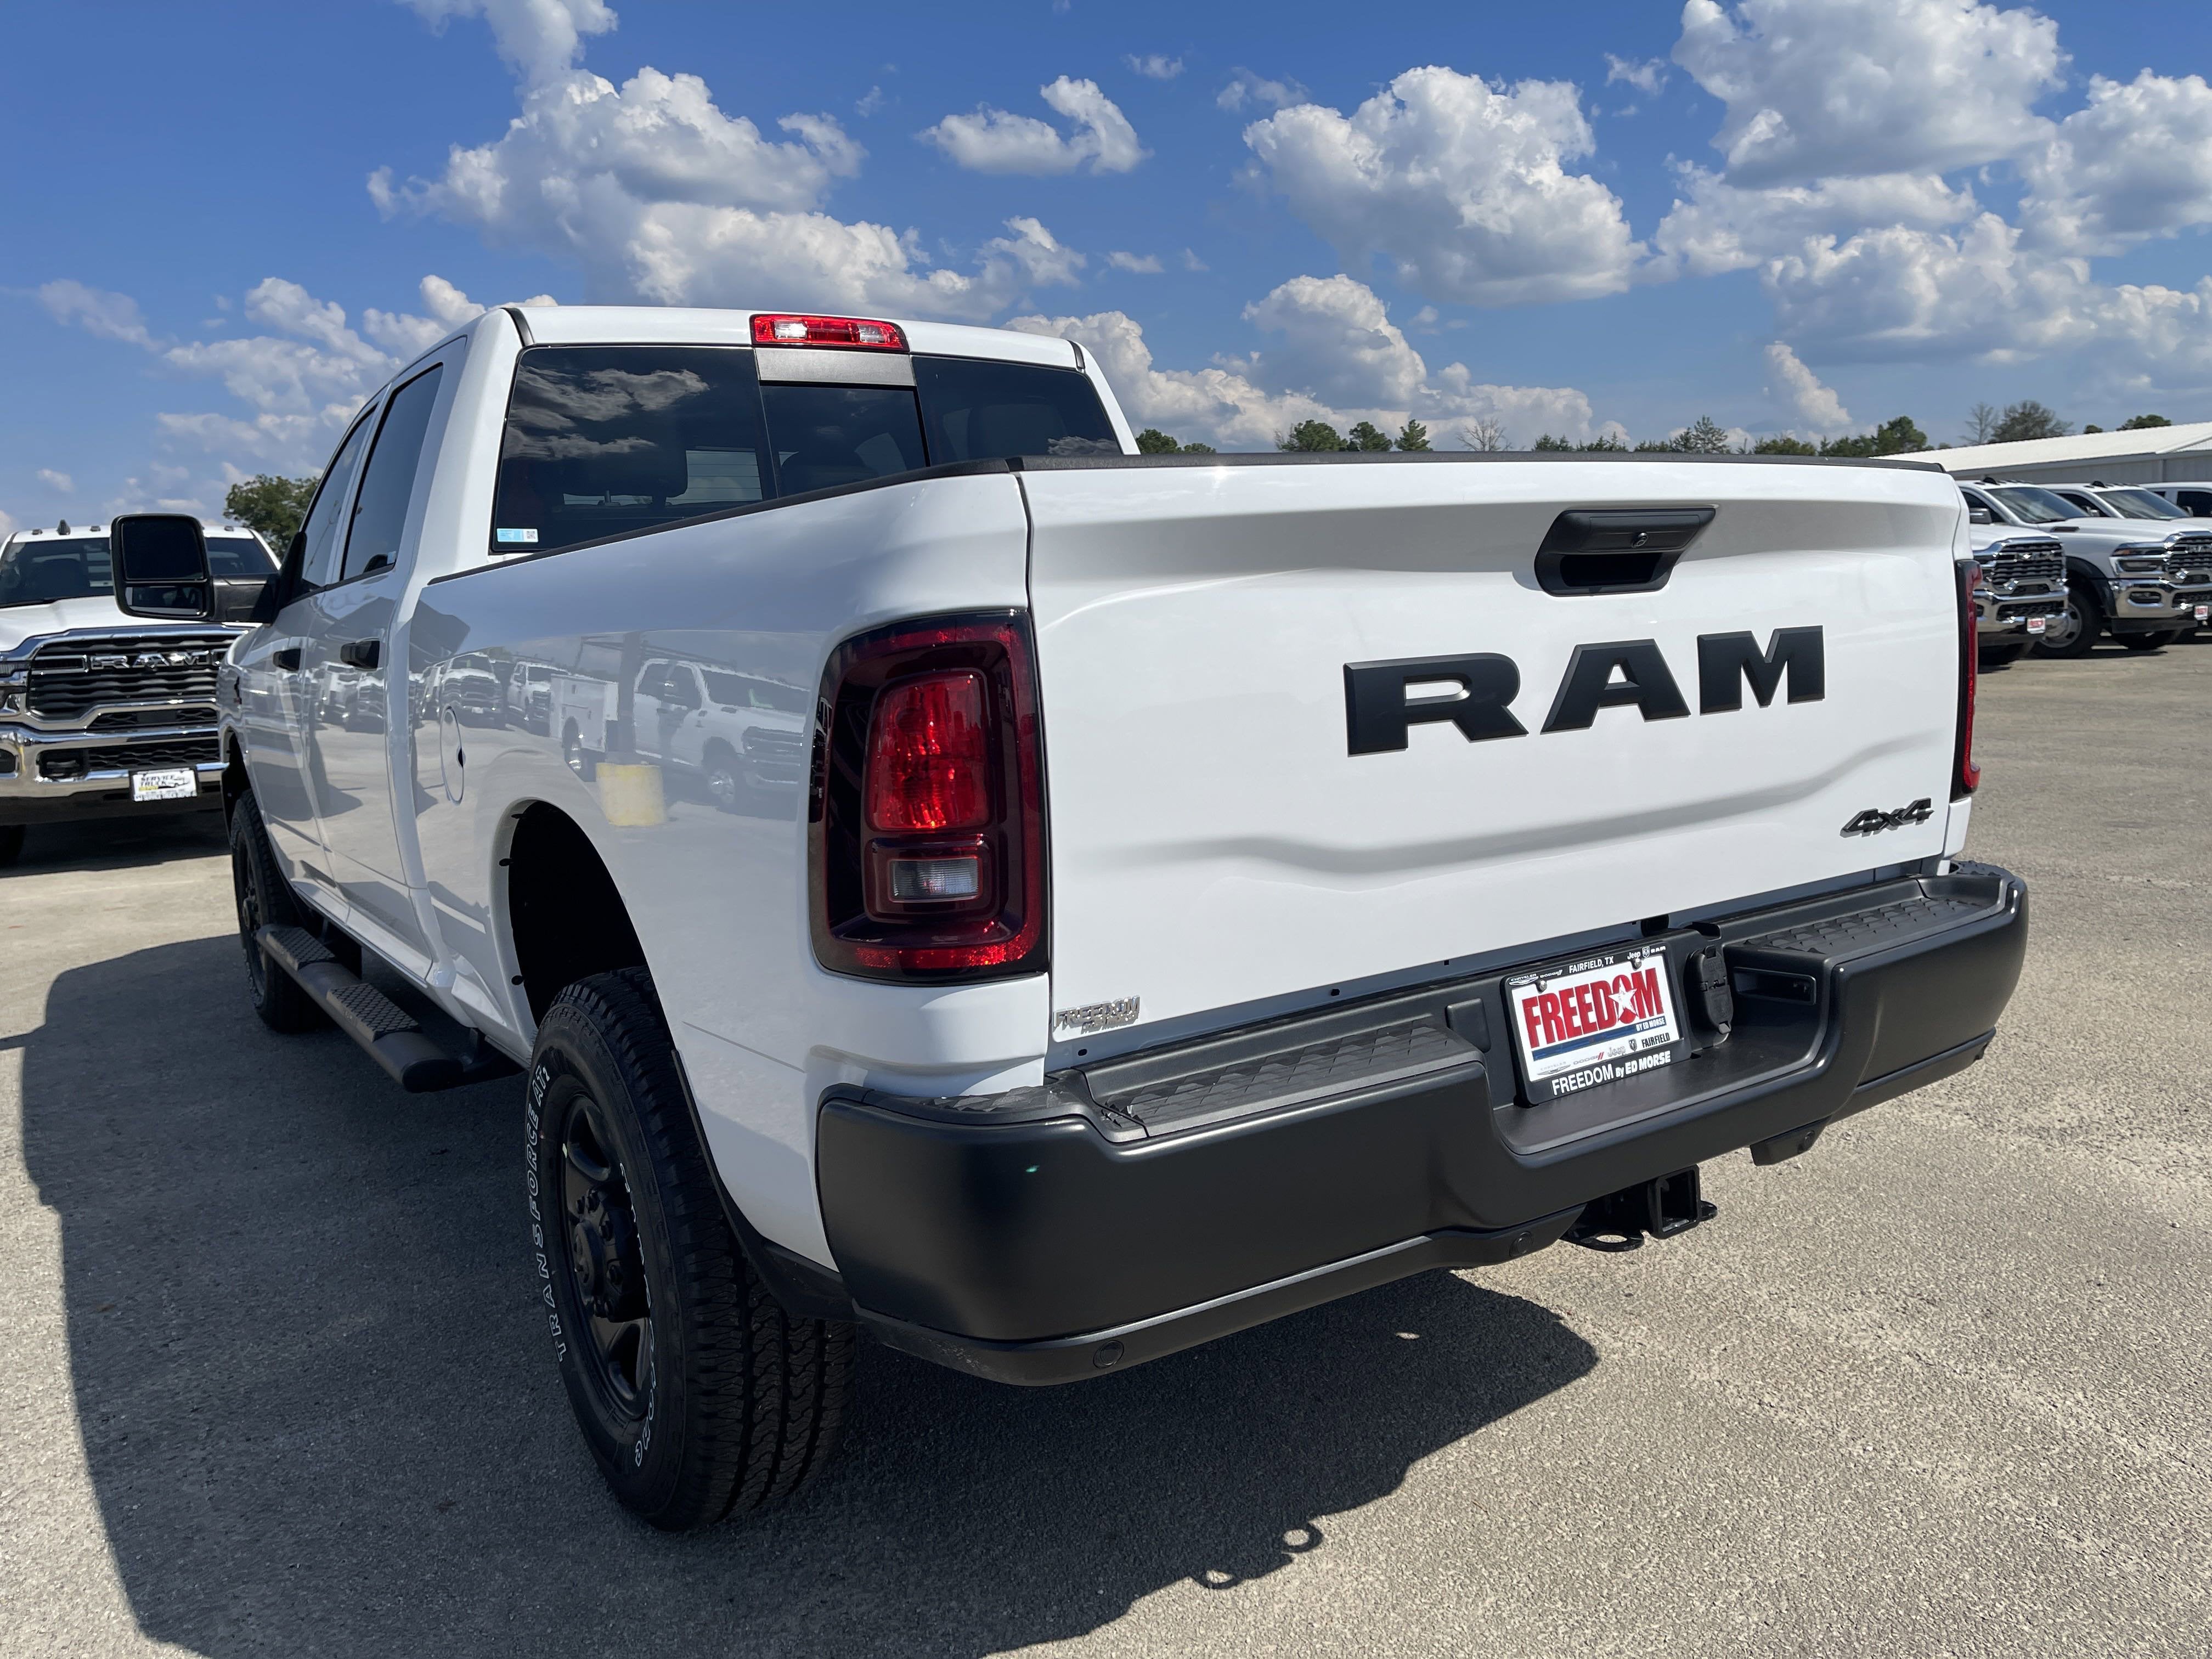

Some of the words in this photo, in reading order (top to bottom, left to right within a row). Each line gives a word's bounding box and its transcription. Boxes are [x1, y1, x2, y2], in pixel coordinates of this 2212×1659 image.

[89, 650, 213, 670] RAM
[1342, 624, 1825, 757] RAM
[1839, 797, 1935, 838] 4x4
[1627, 951, 1641, 960] Jeep
[1650, 945, 1666, 953] RAM
[1568, 958, 1604, 974] FAIRFIELD,
[1604, 956, 1614, 965] TX
[1510, 973, 1537, 981] CHRYSLER
[1521, 968, 1664, 1048] FREEDOM
[1635, 1023, 1643, 1031] BY
[1643, 1022, 1649, 1030] ED
[1649, 1017, 1666, 1028] MORSE
[1641, 1032, 1671, 1048] FAIRFIELD
[1607, 1045, 1626, 1057] Jeep
[1540, 1061, 1567, 1071] CHRYSLER
[1573, 1055, 1599, 1065] DODGE
[1551, 1063, 1614, 1096] FREEDOM
[1615, 1066, 1624, 1078] By
[1625, 1060, 1638, 1075] ED
[1638, 1050, 1671, 1071] MORSE
[526, 1103, 567, 1363] TRANSFORCE
